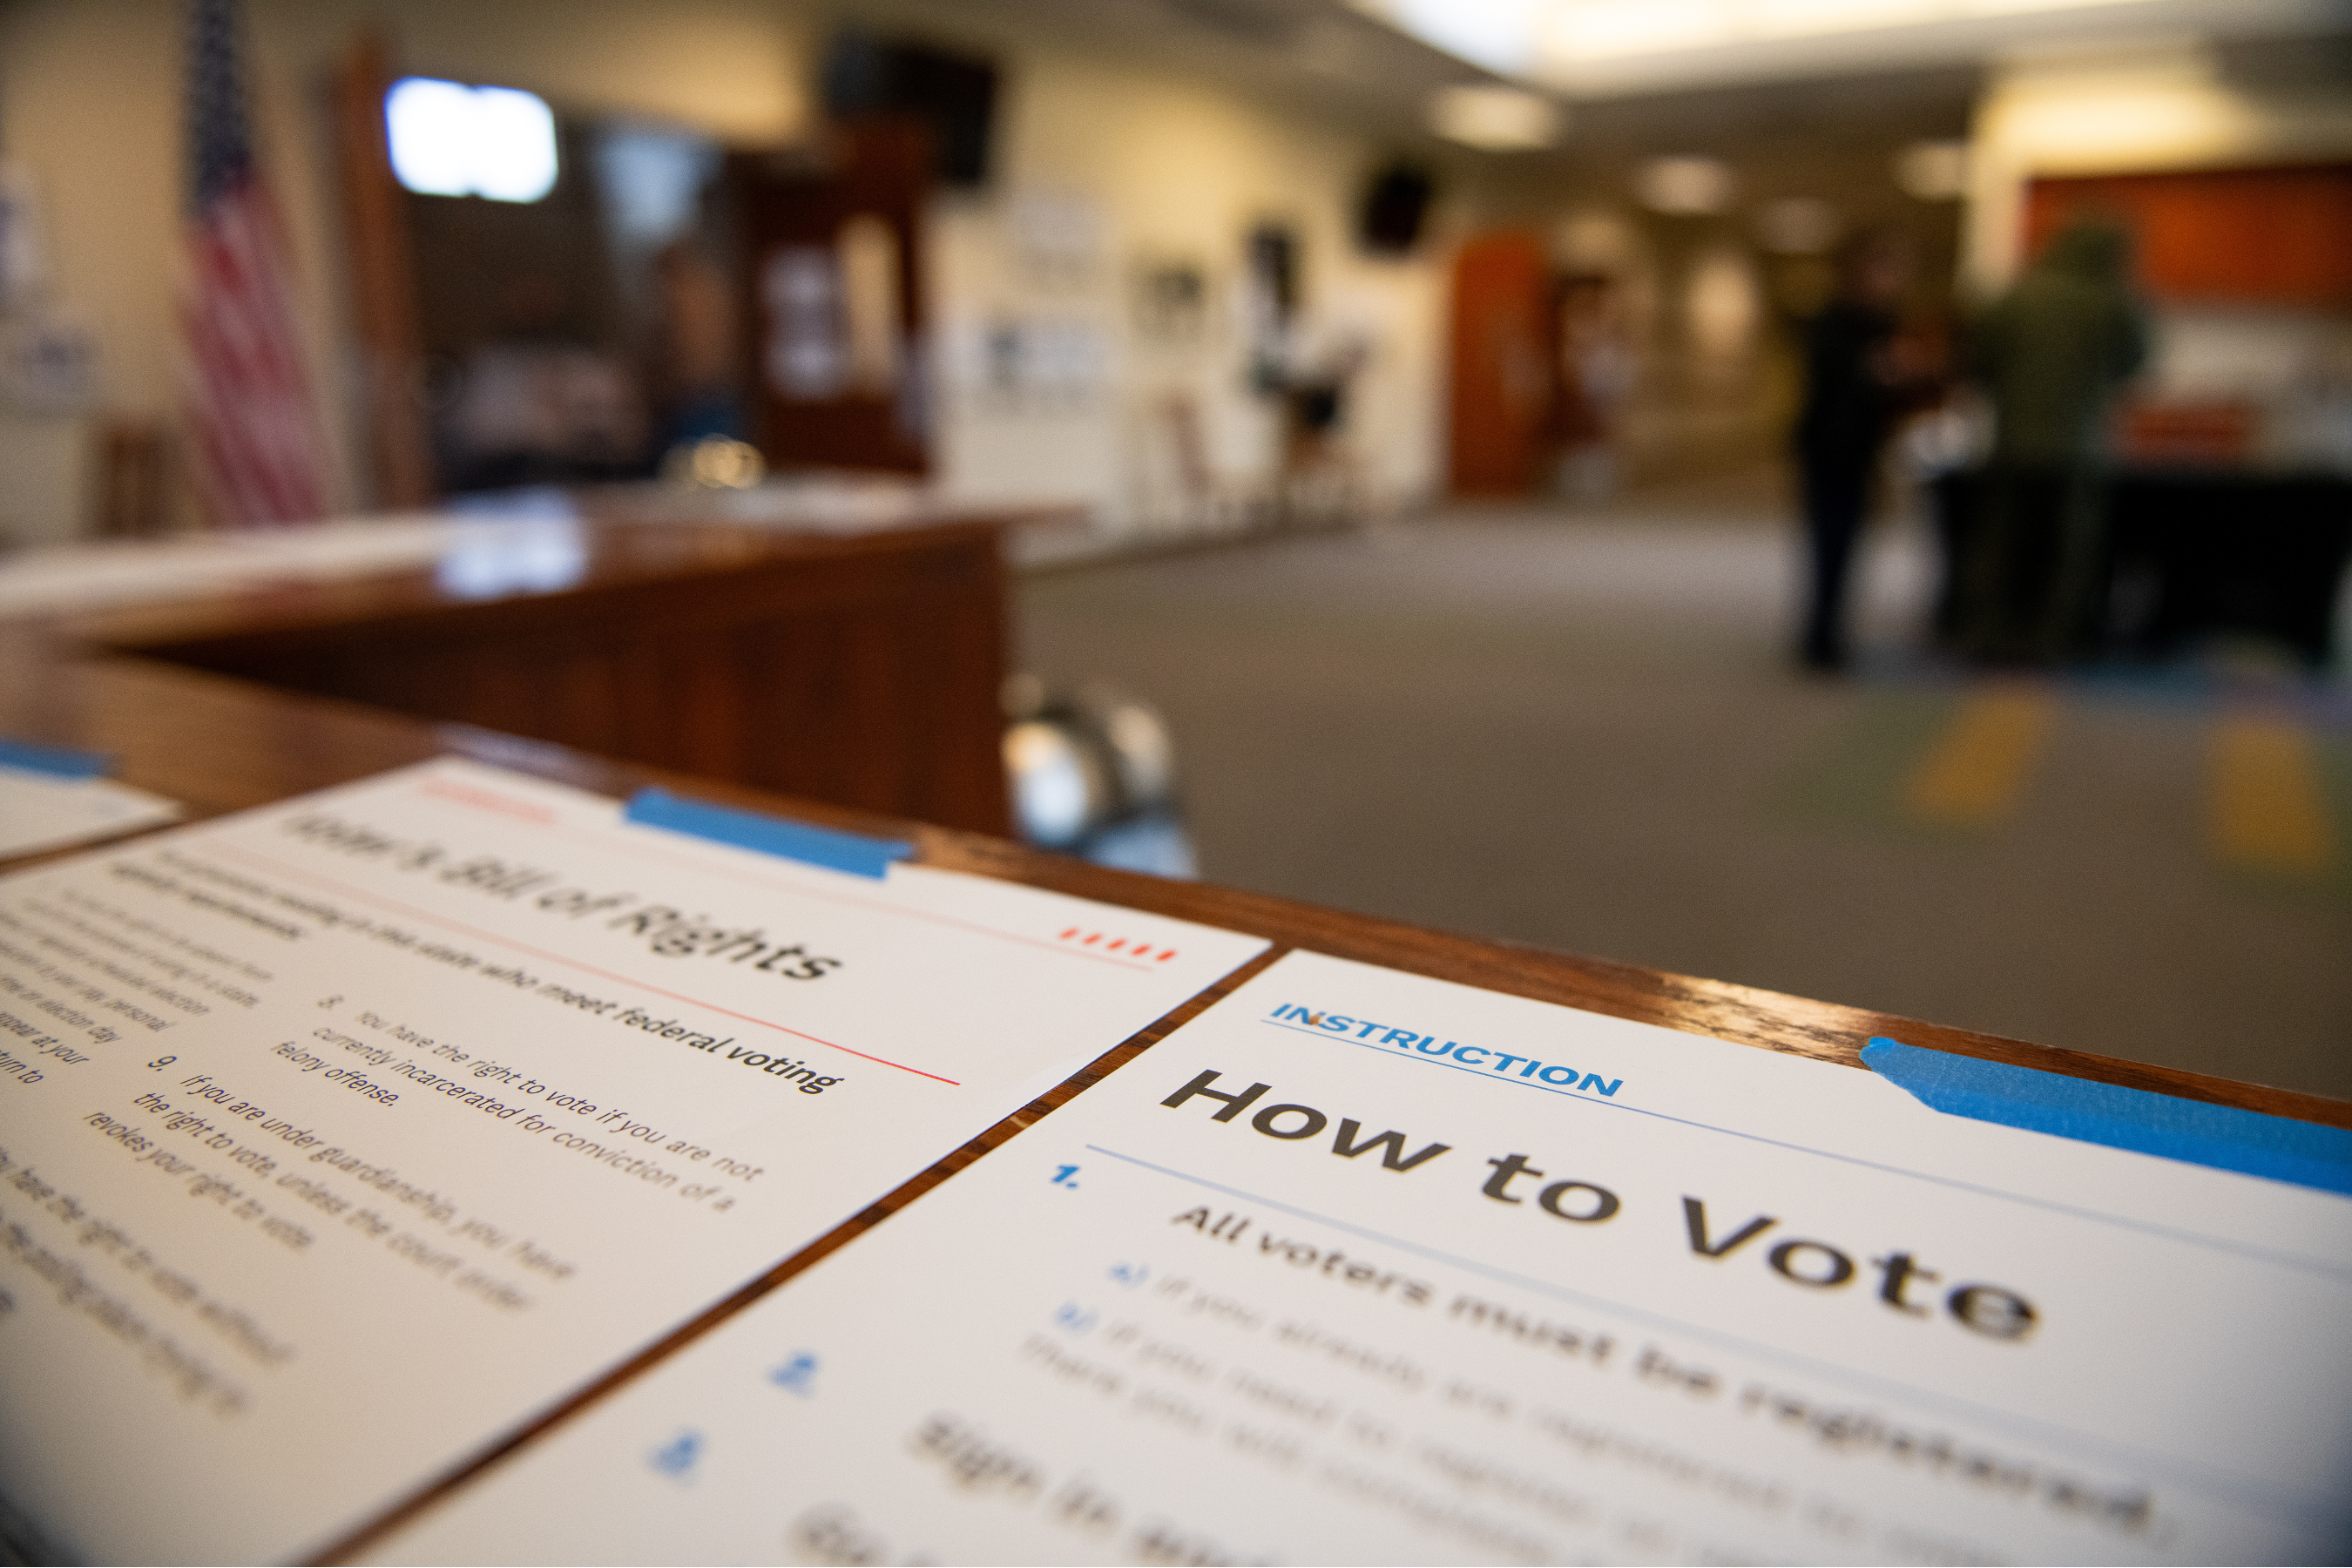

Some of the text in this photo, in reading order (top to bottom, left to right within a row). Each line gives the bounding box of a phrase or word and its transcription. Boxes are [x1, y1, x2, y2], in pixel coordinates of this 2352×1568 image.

[609, 902, 843, 984] Rights
[386, 1023, 435, 1048] have
[39, 1044, 90, 1064] your
[431, 1044, 470, 1064] the
[613, 1007, 732, 1054] federal
[727, 1043, 845, 1095] voting
[1270, 1003, 1624, 1097] INSTRUCTION
[146, 1055, 178, 1071] 9.
[270, 1040, 400, 1107] felony offense.
[466, 1060, 522, 1085] right
[17, 1069, 44, 1084] to
[179, 1074, 213, 1087] If
[517, 1078, 546, 1095] to
[186, 1085, 236, 1105] you
[545, 1091, 598, 1116] vote
[226, 1101, 267, 1121] are
[311, 1026, 397, 1067] currently
[389, 1059, 526, 1120] incarcerated
[514, 1113, 557, 1134] for
[551, 1132, 679, 1190] conviction
[595, 1109, 628, 1125] if
[132, 1092, 171, 1113] the
[161, 1111, 215, 1138] right
[204, 1132, 234, 1150] to
[607, 1120, 667, 1145] you
[83, 1112, 153, 1153] revokes
[135, 1148, 197, 1175] your
[259, 1119, 326, 1150] under
[665, 1139, 712, 1162] are
[711, 1156, 766, 1183] not
[1051, 1165, 1082, 1189] 1.
[1159, 1069, 2040, 1342] How to Vote
[1172, 1204, 1252, 1245] All
[1258, 1232, 1439, 1307] voters
[1450, 1294, 1620, 1366] must
